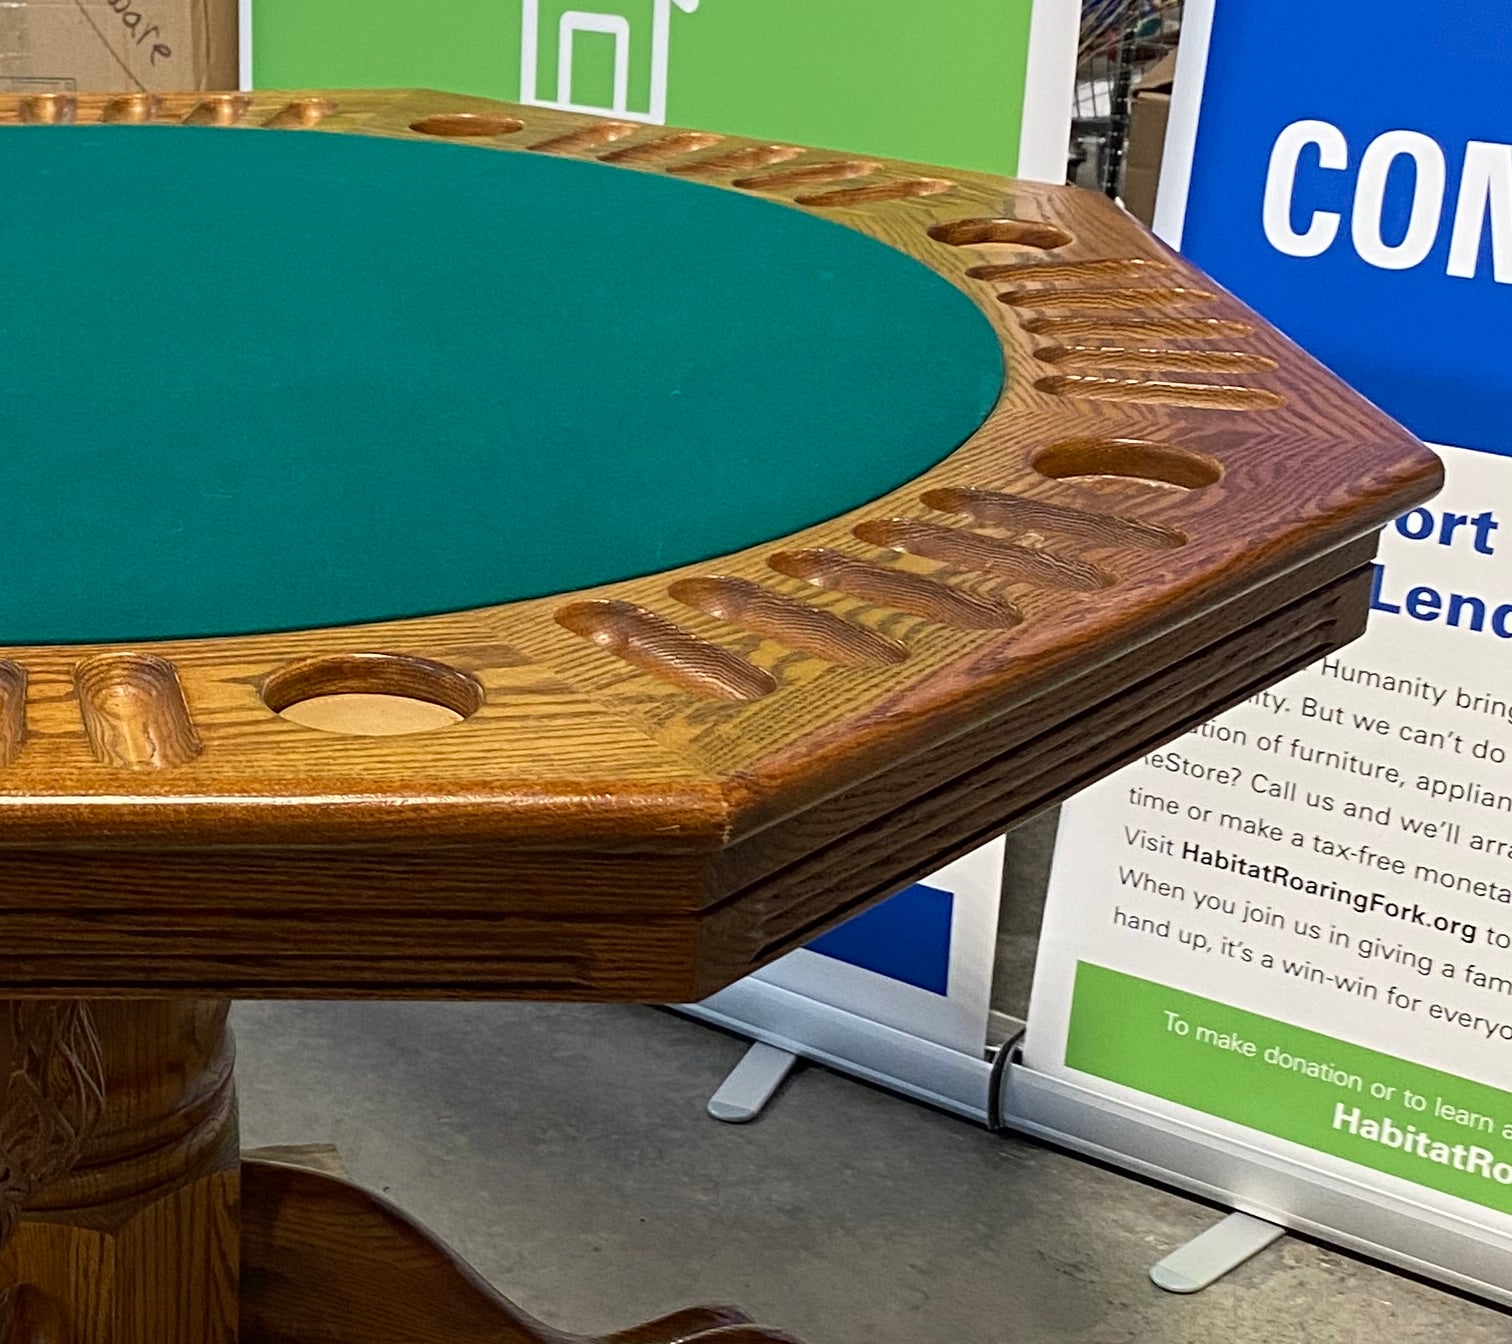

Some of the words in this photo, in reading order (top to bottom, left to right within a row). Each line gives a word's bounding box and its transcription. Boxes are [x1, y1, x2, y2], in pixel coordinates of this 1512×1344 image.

[1395, 507, 1499, 555] ort
[1248, 690, 1291, 714] ity.
[1301, 696, 1345, 725] But
[1353, 713, 1390, 735] we
[1399, 725, 1464, 754] can't
[1472, 739, 1506, 763] do
[1321, 657, 1447, 706] Humanity
[1456, 687, 1512, 724] brin
[1144, 752, 1242, 787] eStore?
[1251, 773, 1297, 802] Call
[1306, 792, 1335, 812] us
[1343, 802, 1391, 826] and
[1469, 834, 1512, 860] arr
[1189, 719, 1247, 746] tion
[1256, 734, 1284, 754] of
[1290, 738, 1406, 788] furniture,
[1416, 775, 1512, 813] applian
[1124, 825, 1175, 857] Visit
[1182, 841, 1477, 944] HabitatRoaringFork.org
[1487, 927, 1511, 949] to
[1128, 787, 1180, 815] time
[1187, 805, 1213, 822] or
[1220, 813, 1284, 842] make
[1291, 832, 1304, 848] a
[1311, 835, 1406, 875] tax-free
[1414, 864, 1512, 904] moneta
[1113, 906, 1171, 938] hand
[1179, 928, 1212, 953] up,
[1221, 936, 1253, 963] it's
[1260, 954, 1274, 969] a
[1282, 959, 1378, 1001] win-win
[1387, 986, 1423, 1012] for
[1119, 865, 1185, 902] When
[1193, 891, 1236, 915] you
[1242, 900, 1286, 929] join
[1294, 920, 1321, 940] us
[1329, 925, 1350, 949] in
[1358, 937, 1433, 977] giving
[1442, 963, 1455, 979] a
[1163, 1010, 1190, 1036] To
[1196, 1026, 1257, 1057] make
[1263, 1046, 1363, 1093] donation
[1370, 1082, 1397, 1101] or
[1403, 1089, 1428, 1112] to
[1434, 1097, 1494, 1134] learn
[1332, 1102, 1512, 1186] HabitatRo
